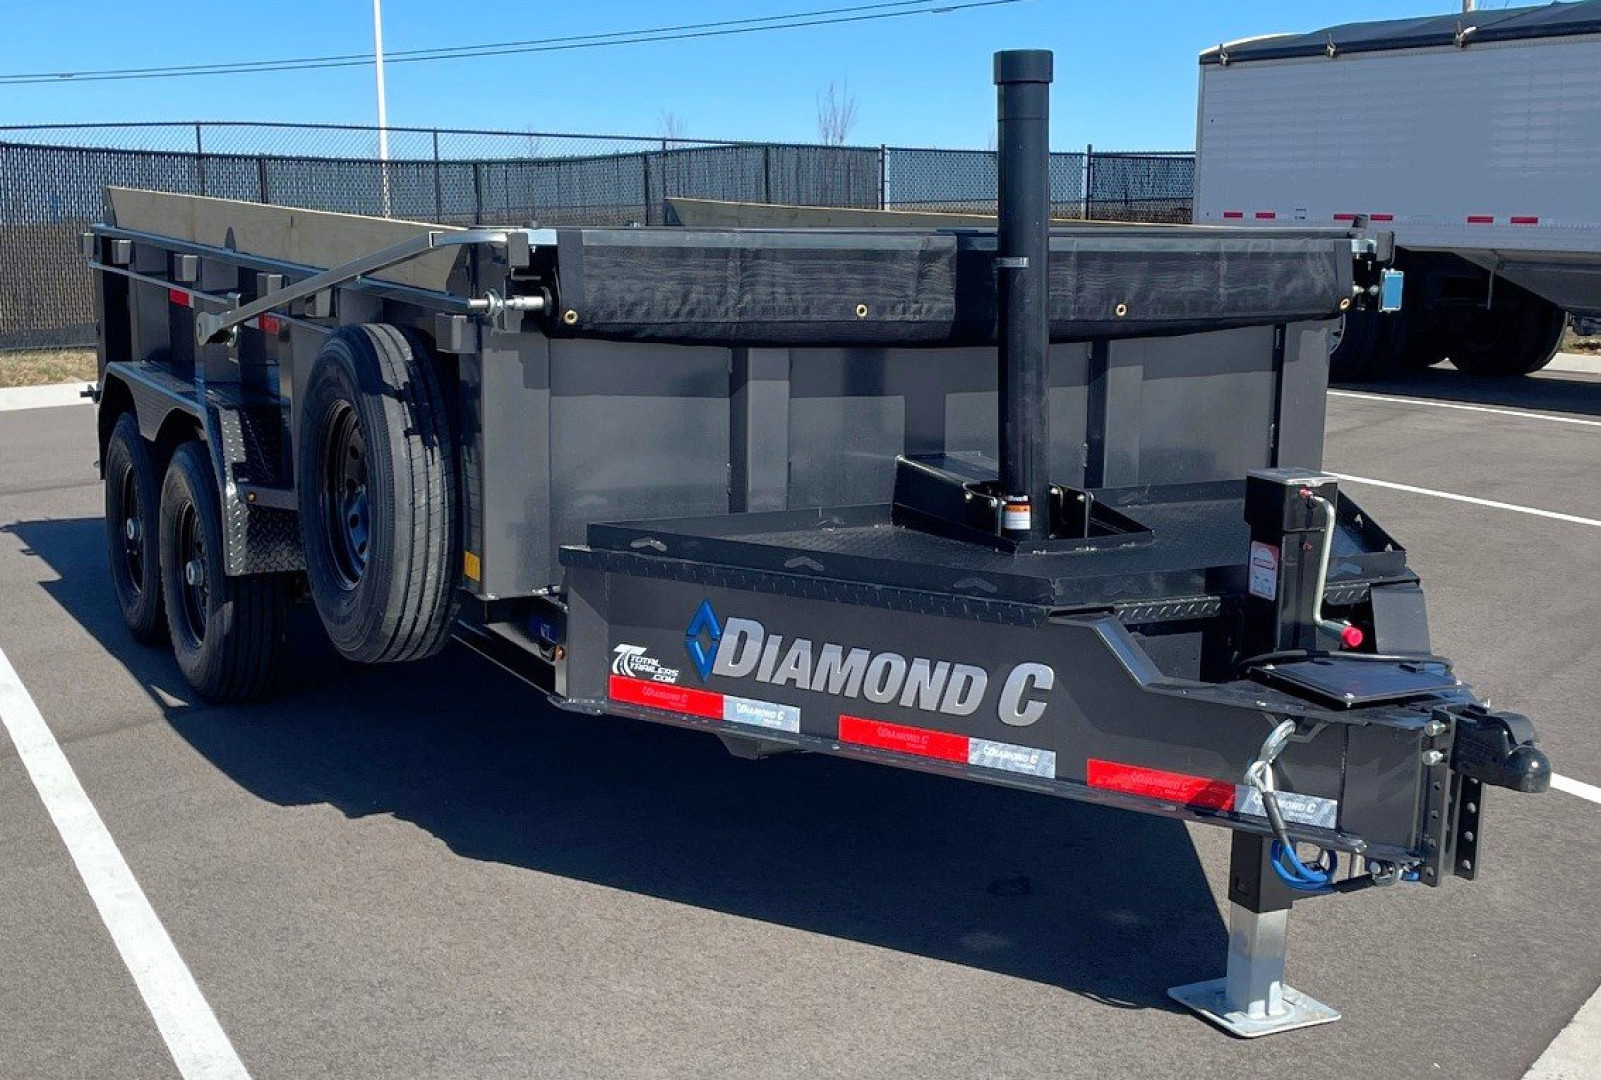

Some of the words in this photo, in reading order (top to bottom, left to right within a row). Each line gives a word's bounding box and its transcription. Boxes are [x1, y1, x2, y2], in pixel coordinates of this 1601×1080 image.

[630, 654, 661, 667] TOTAL
[630, 662, 680, 677] TRAILERS
[712, 616, 988, 717] DIAMOND
[997, 661, 1054, 727] C
[921, 735, 930, 745] C
[1306, 803, 1317, 814] C
